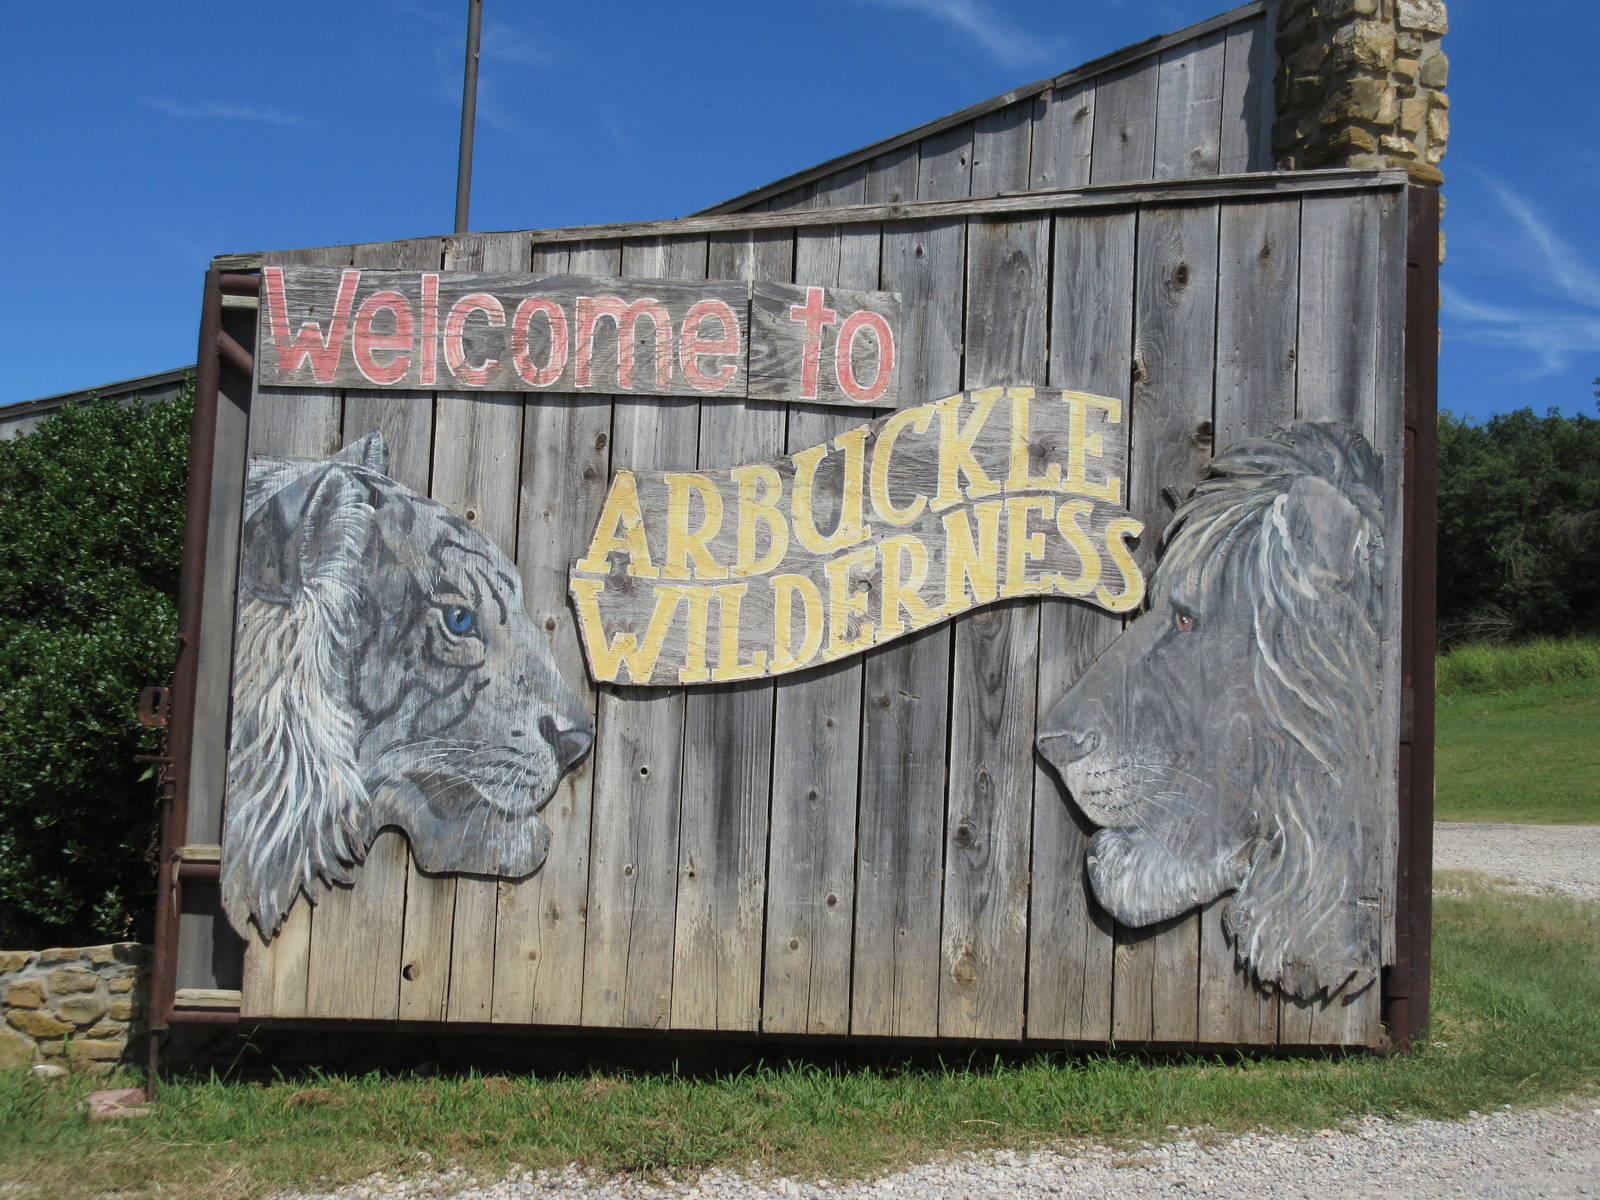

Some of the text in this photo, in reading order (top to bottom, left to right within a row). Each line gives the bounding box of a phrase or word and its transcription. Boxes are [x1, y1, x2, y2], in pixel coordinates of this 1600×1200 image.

[264, 267, 895, 402] Welcome to
[576, 387, 1122, 579] ARBUCKLE
[570, 496, 1146, 683] WILDERNESS
